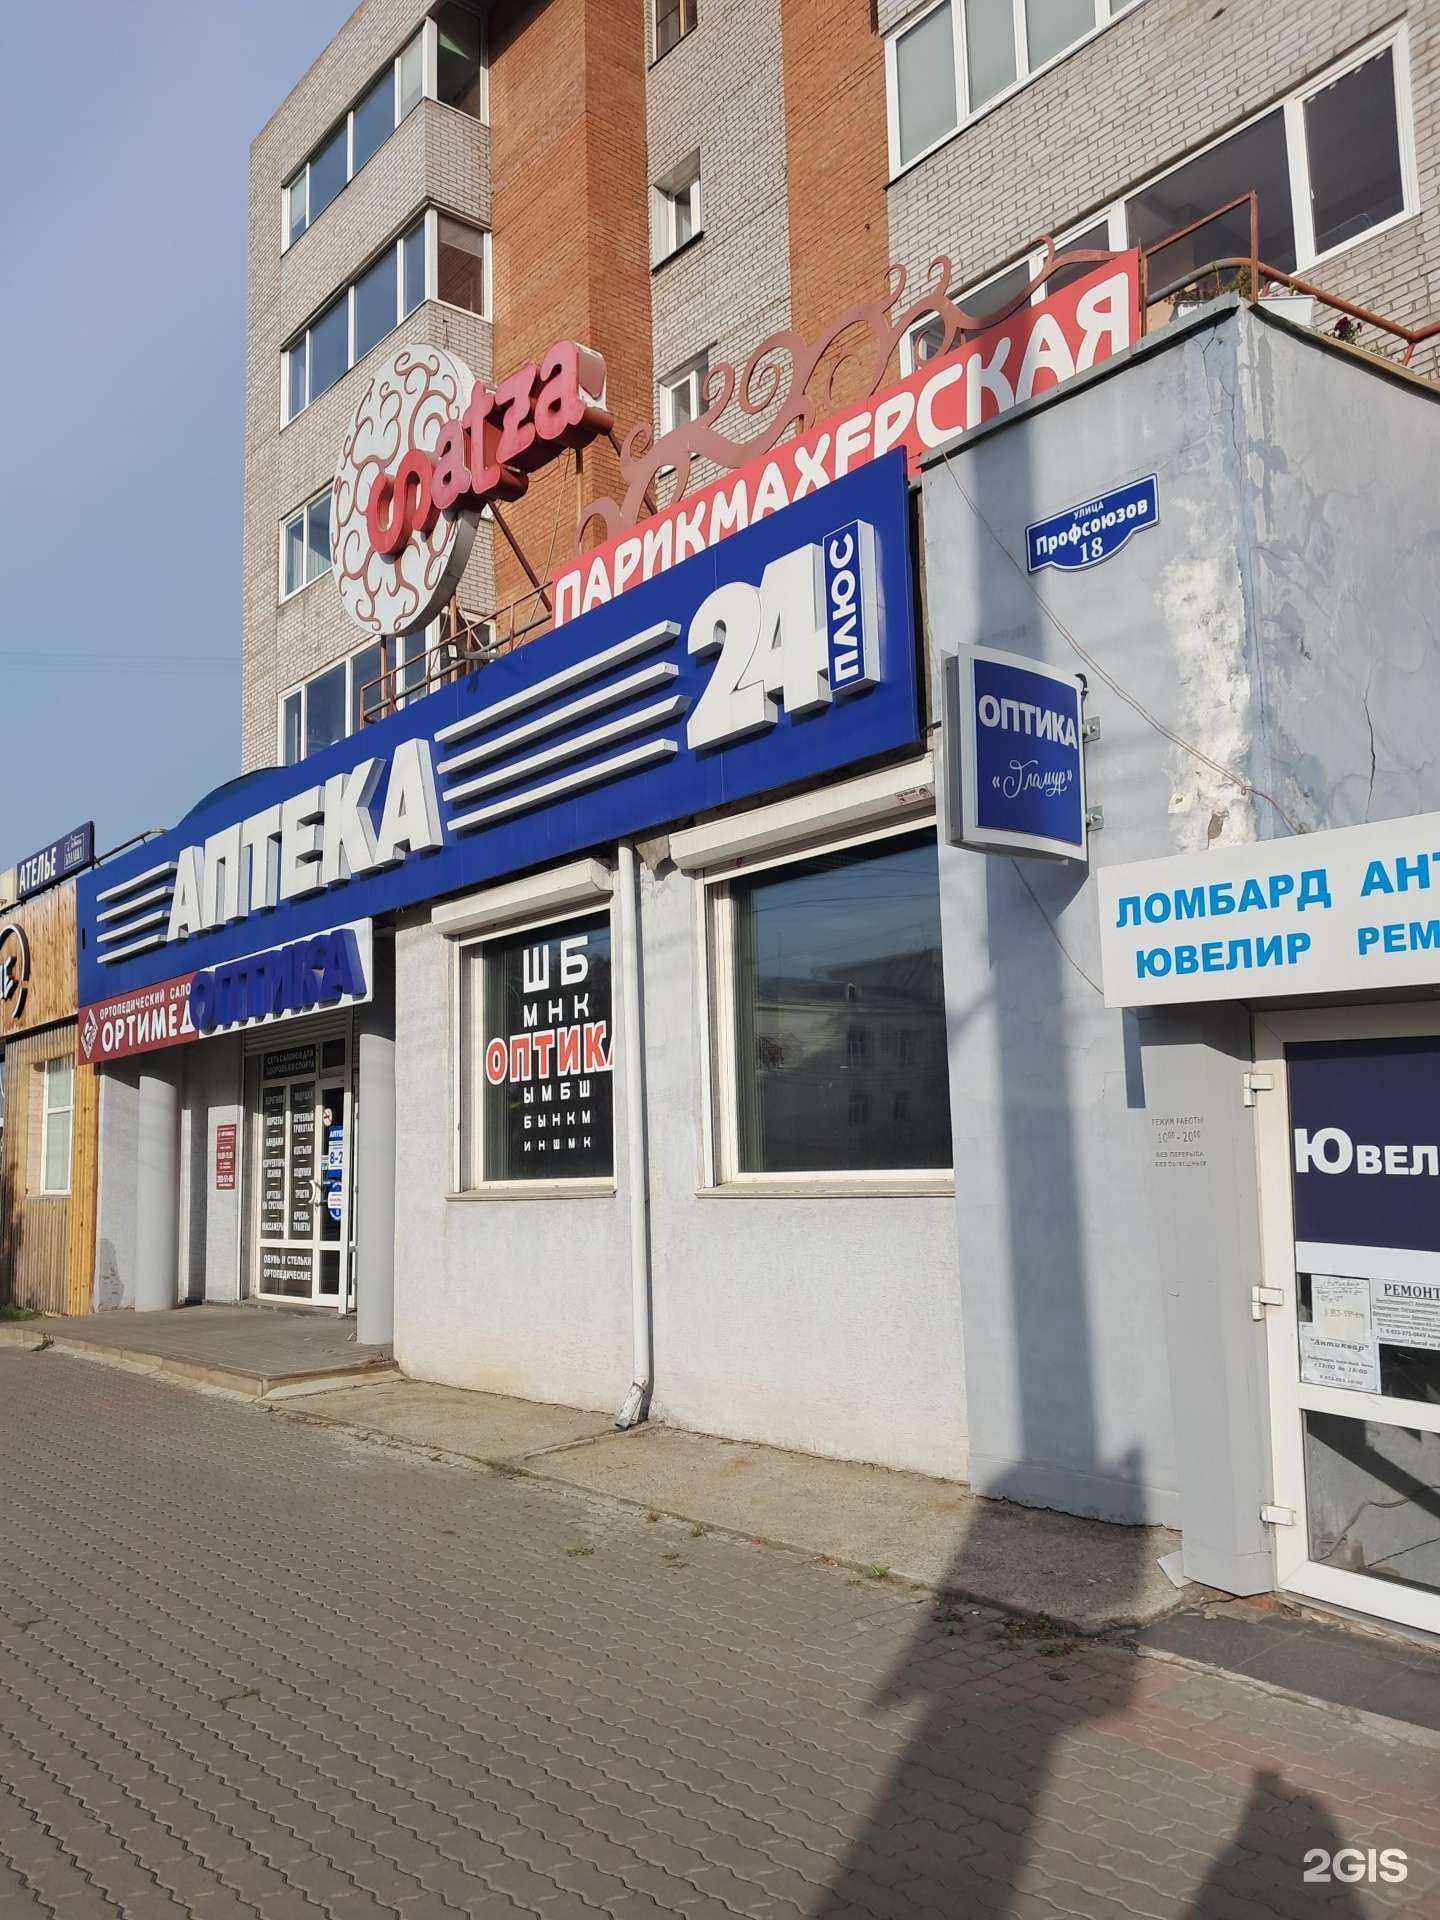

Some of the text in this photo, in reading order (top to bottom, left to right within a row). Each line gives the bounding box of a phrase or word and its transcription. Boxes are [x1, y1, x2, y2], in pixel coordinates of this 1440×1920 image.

[554, 271, 1131, 628] ПАРИКМАХЕРСКАЯ
[1036, 499, 1148, 556] Профсоюзов
[1073, 501, 1104, 520] УЛИЦА
[1080, 537, 1104, 562] 18
[829, 532, 860, 682] ПЛЮС
[167, 542, 833, 941] АПТЕКА 24
[978, 694, 1078, 750] ОПТИКА
[19, 846, 57, 894] АТЕЛЬЕ
[1116, 868, 1332, 928] ЛОМБАРД
[1136, 919, 1440, 979] ЮВЕЛИР РЕМ
[99, 989, 165, 1020] ОРТОПЕДИЧЕСКИЙ
[190, 929, 367, 1035] ОПТИКА
[101, 1000, 196, 1053] ОРТИМЕД
[263, 1254, 312, 1266] ОБУВЬ И СТЕЛЬКИ
[263, 1268, 312, 1282] ОРТОПЕДИЧЕСКИЕ
